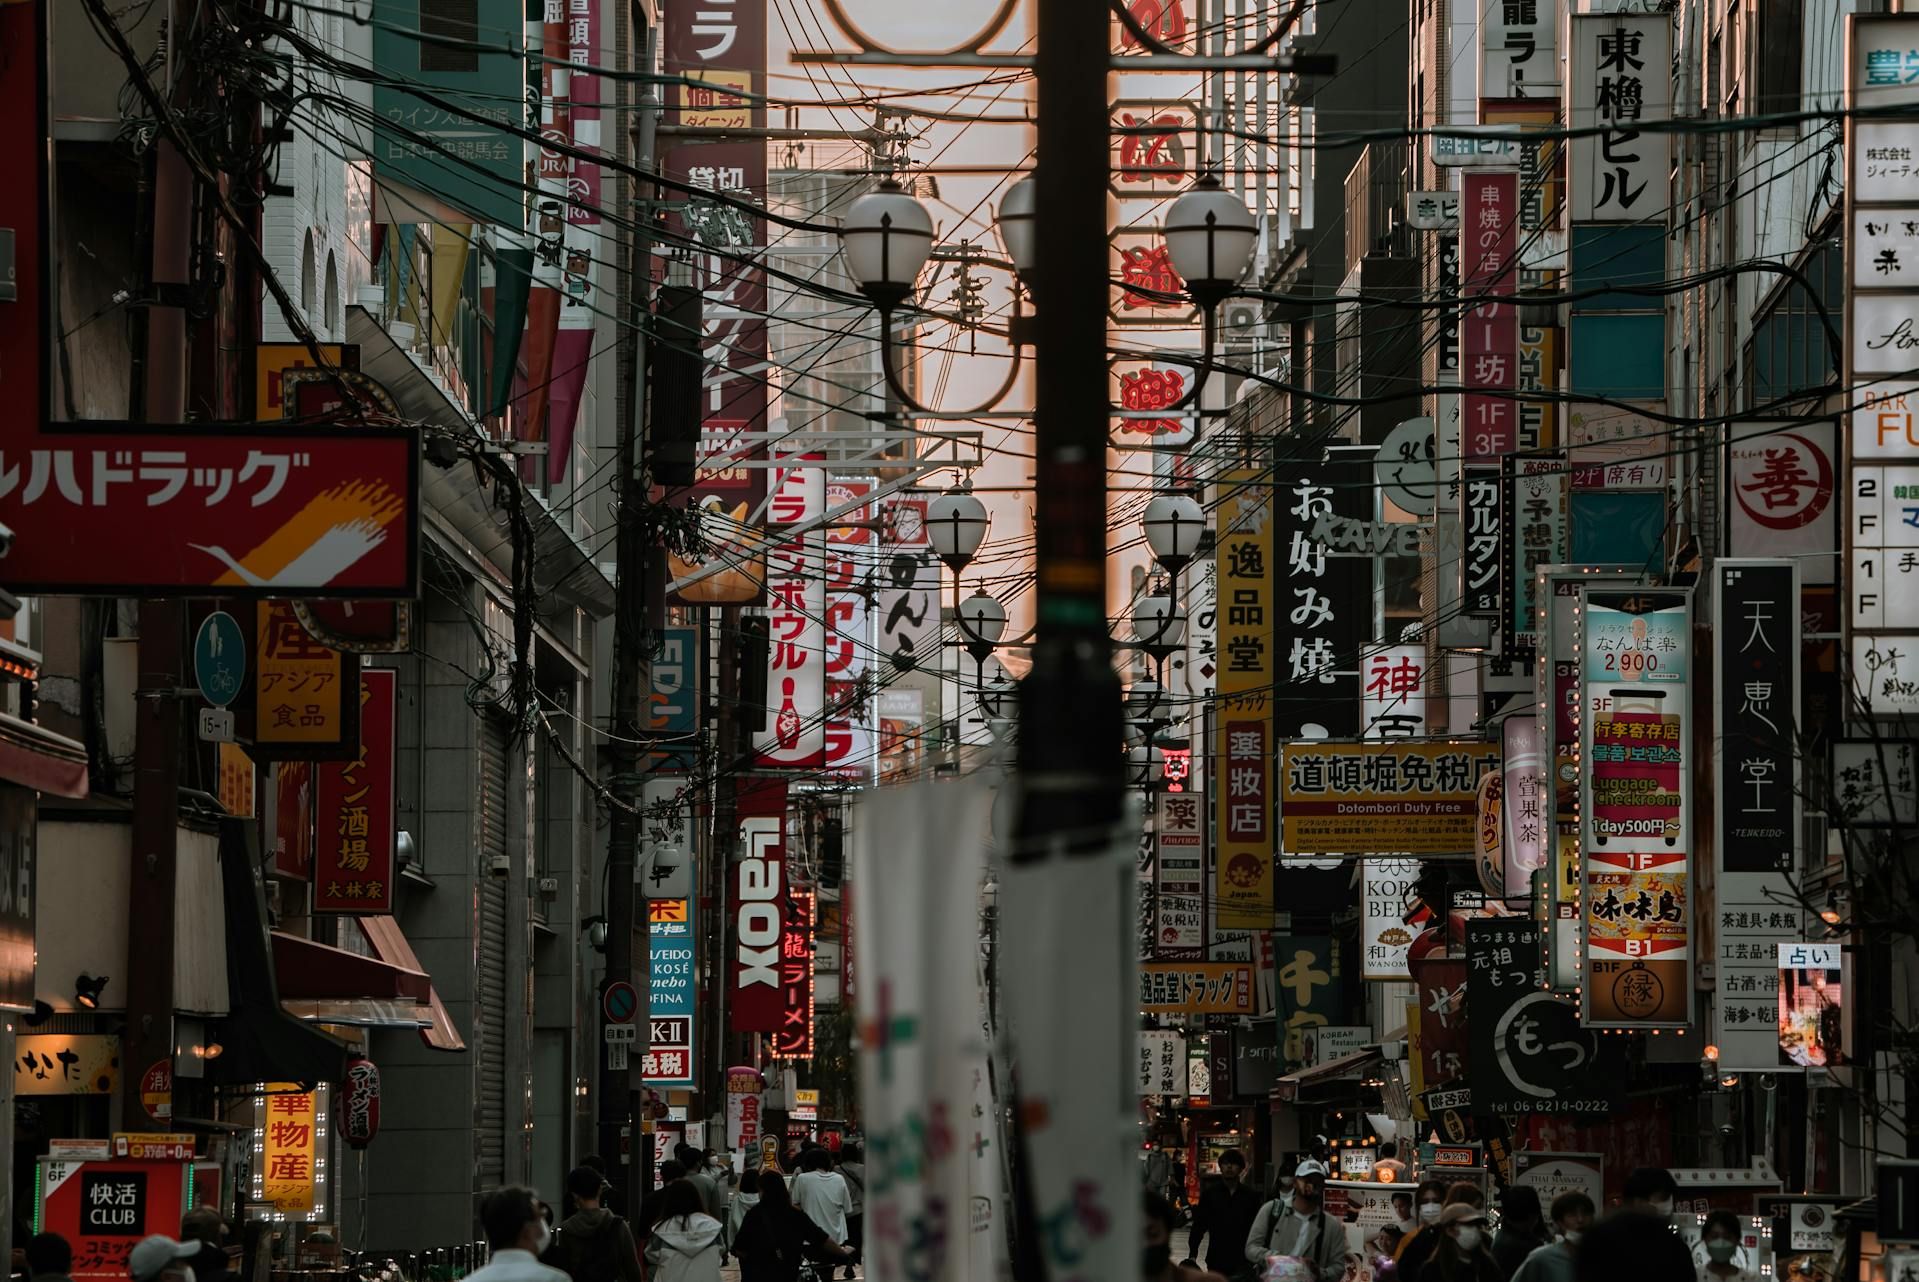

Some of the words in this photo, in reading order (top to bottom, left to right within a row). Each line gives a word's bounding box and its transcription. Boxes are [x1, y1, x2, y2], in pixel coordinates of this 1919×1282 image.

[691, 0, 736, 60] ラ
[1866, 148, 1910, 160] 株式会社
[569, 206, 591, 219] RA
[1479, 185, 1502, 273] 串焼の店
[1866, 392, 1908, 410] BAR
[1477, 403, 1506, 424] 1F
[1475, 434, 1506, 455] 3F
[1607, 464, 1662, 484] 席有り
[1741, 447, 1819, 509] 善
[1310, 510, 1419, 557] KAVE
[1468, 481, 1499, 589] カルダン
[1289, 477, 1337, 686] お好み焼
[1228, 542, 1264, 671] 逸品堂
[1596, 636, 1677, 652] なんば楽
[262, 671, 335, 693] アジア
[1592, 698, 1612, 711] 3F
[1738, 600, 1778, 812] 天恵堂
[203, 716, 229, 734] 15-1
[271, 704, 325, 728] 食品
[1594, 721, 1680, 740] 行李寄存店
[1592, 745, 1626, 762] 물품
[1629, 746, 1681, 763] 보관소
[336, 683, 372, 872] メン酒場
[1592, 775, 1657, 793] Luggage
[1595, 792, 1681, 806] Checkroom
[1165, 798, 1196, 829] 薬
[1404, 803, 1432, 815] Duty
[1435, 803, 1462, 814] Free
[1483, 776, 1502, 844] 串かつ
[1626, 854, 1654, 870] 1F
[326, 880, 384, 899] 大林家
[1722, 912, 1797, 929] 茶道具・鉄瓶
[1368, 946, 1408, 960] 和ノ
[1626, 940, 1653, 955] B1
[1790, 946, 1829, 966] 占い
[1471, 946, 1513, 970] 元祖
[654, 963, 689, 974] KOSÉ
[1593, 963, 1621, 974] B1F
[650, 978, 686, 988] nebo
[1622, 974, 1654, 1001] 縁
[650, 994, 683, 1004] FINA
[607, 1028, 635, 1039] 自動車
[1320, 1031, 1354, 1040] KOREAN
[1331, 1039, 1368, 1047] Restaurant
[1513, 1014, 1585, 1071] もつ
[15, 1048, 80, 1082] なた
[641, 1052, 683, 1075] 免税
[1161, 1041, 1174, 1092] お好み焼
[350, 1067, 369, 1138] ラーメン酒場
[1491, 1102, 1508, 1112] tel
[269, 1089, 311, 1180] 華物産
[48, 1170, 66, 1181] 6F
[90, 1183, 137, 1206] 快活
[267, 1184, 311, 1194] アジア
[90, 1208, 136, 1225] CLUB
